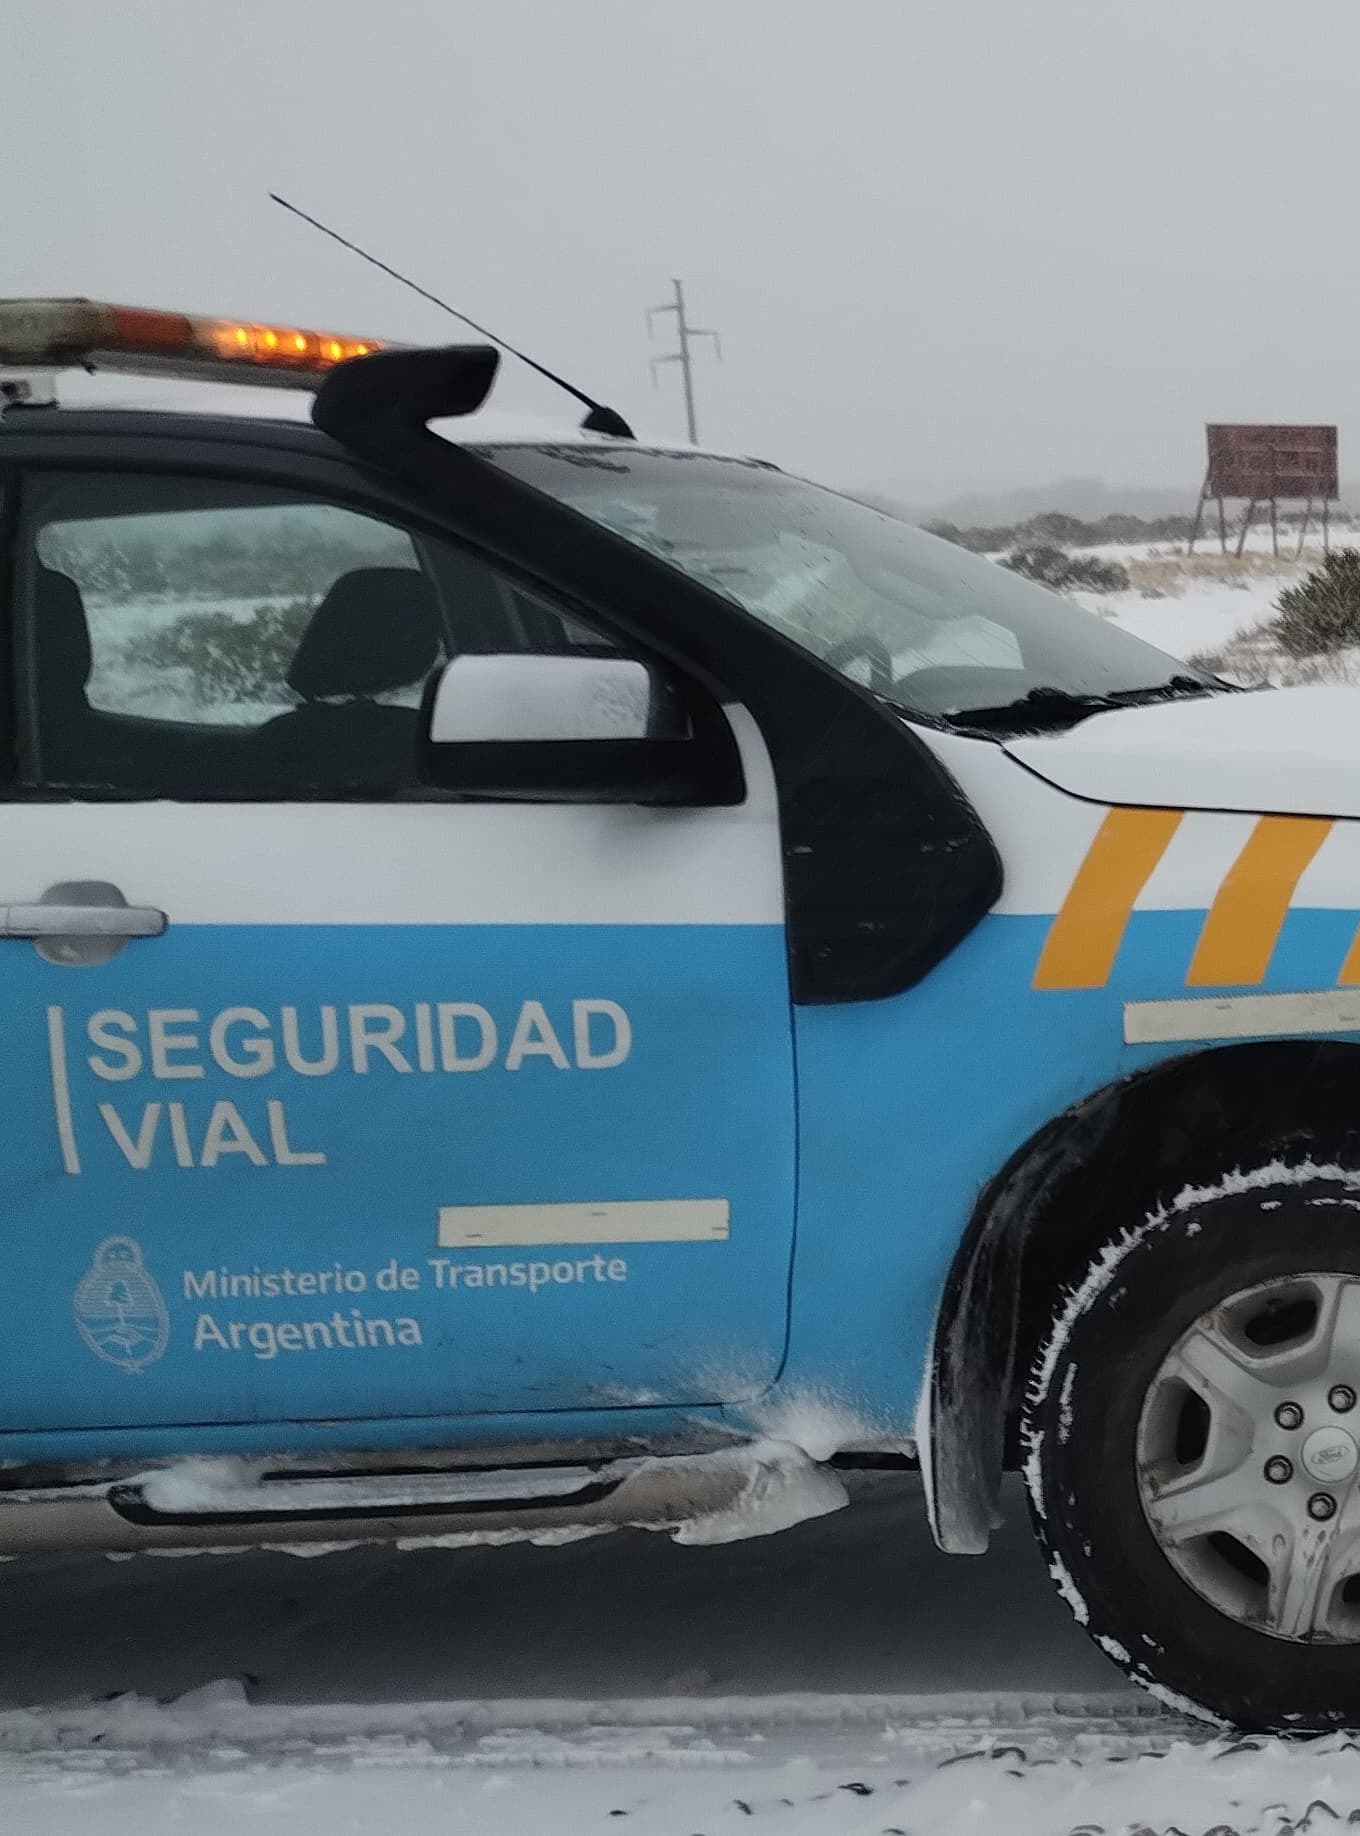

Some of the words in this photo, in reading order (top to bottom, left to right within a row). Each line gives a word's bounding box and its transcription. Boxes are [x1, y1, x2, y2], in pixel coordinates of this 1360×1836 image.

[88, 999, 632, 1080] SEGURIDAD
[100, 1100, 327, 1168] VIAL
[183, 1264, 367, 1298] Ministerio
[376, 1259, 420, 1291] de
[428, 1255, 627, 1292] Transporte
[194, 1309, 422, 1359] Argentina
